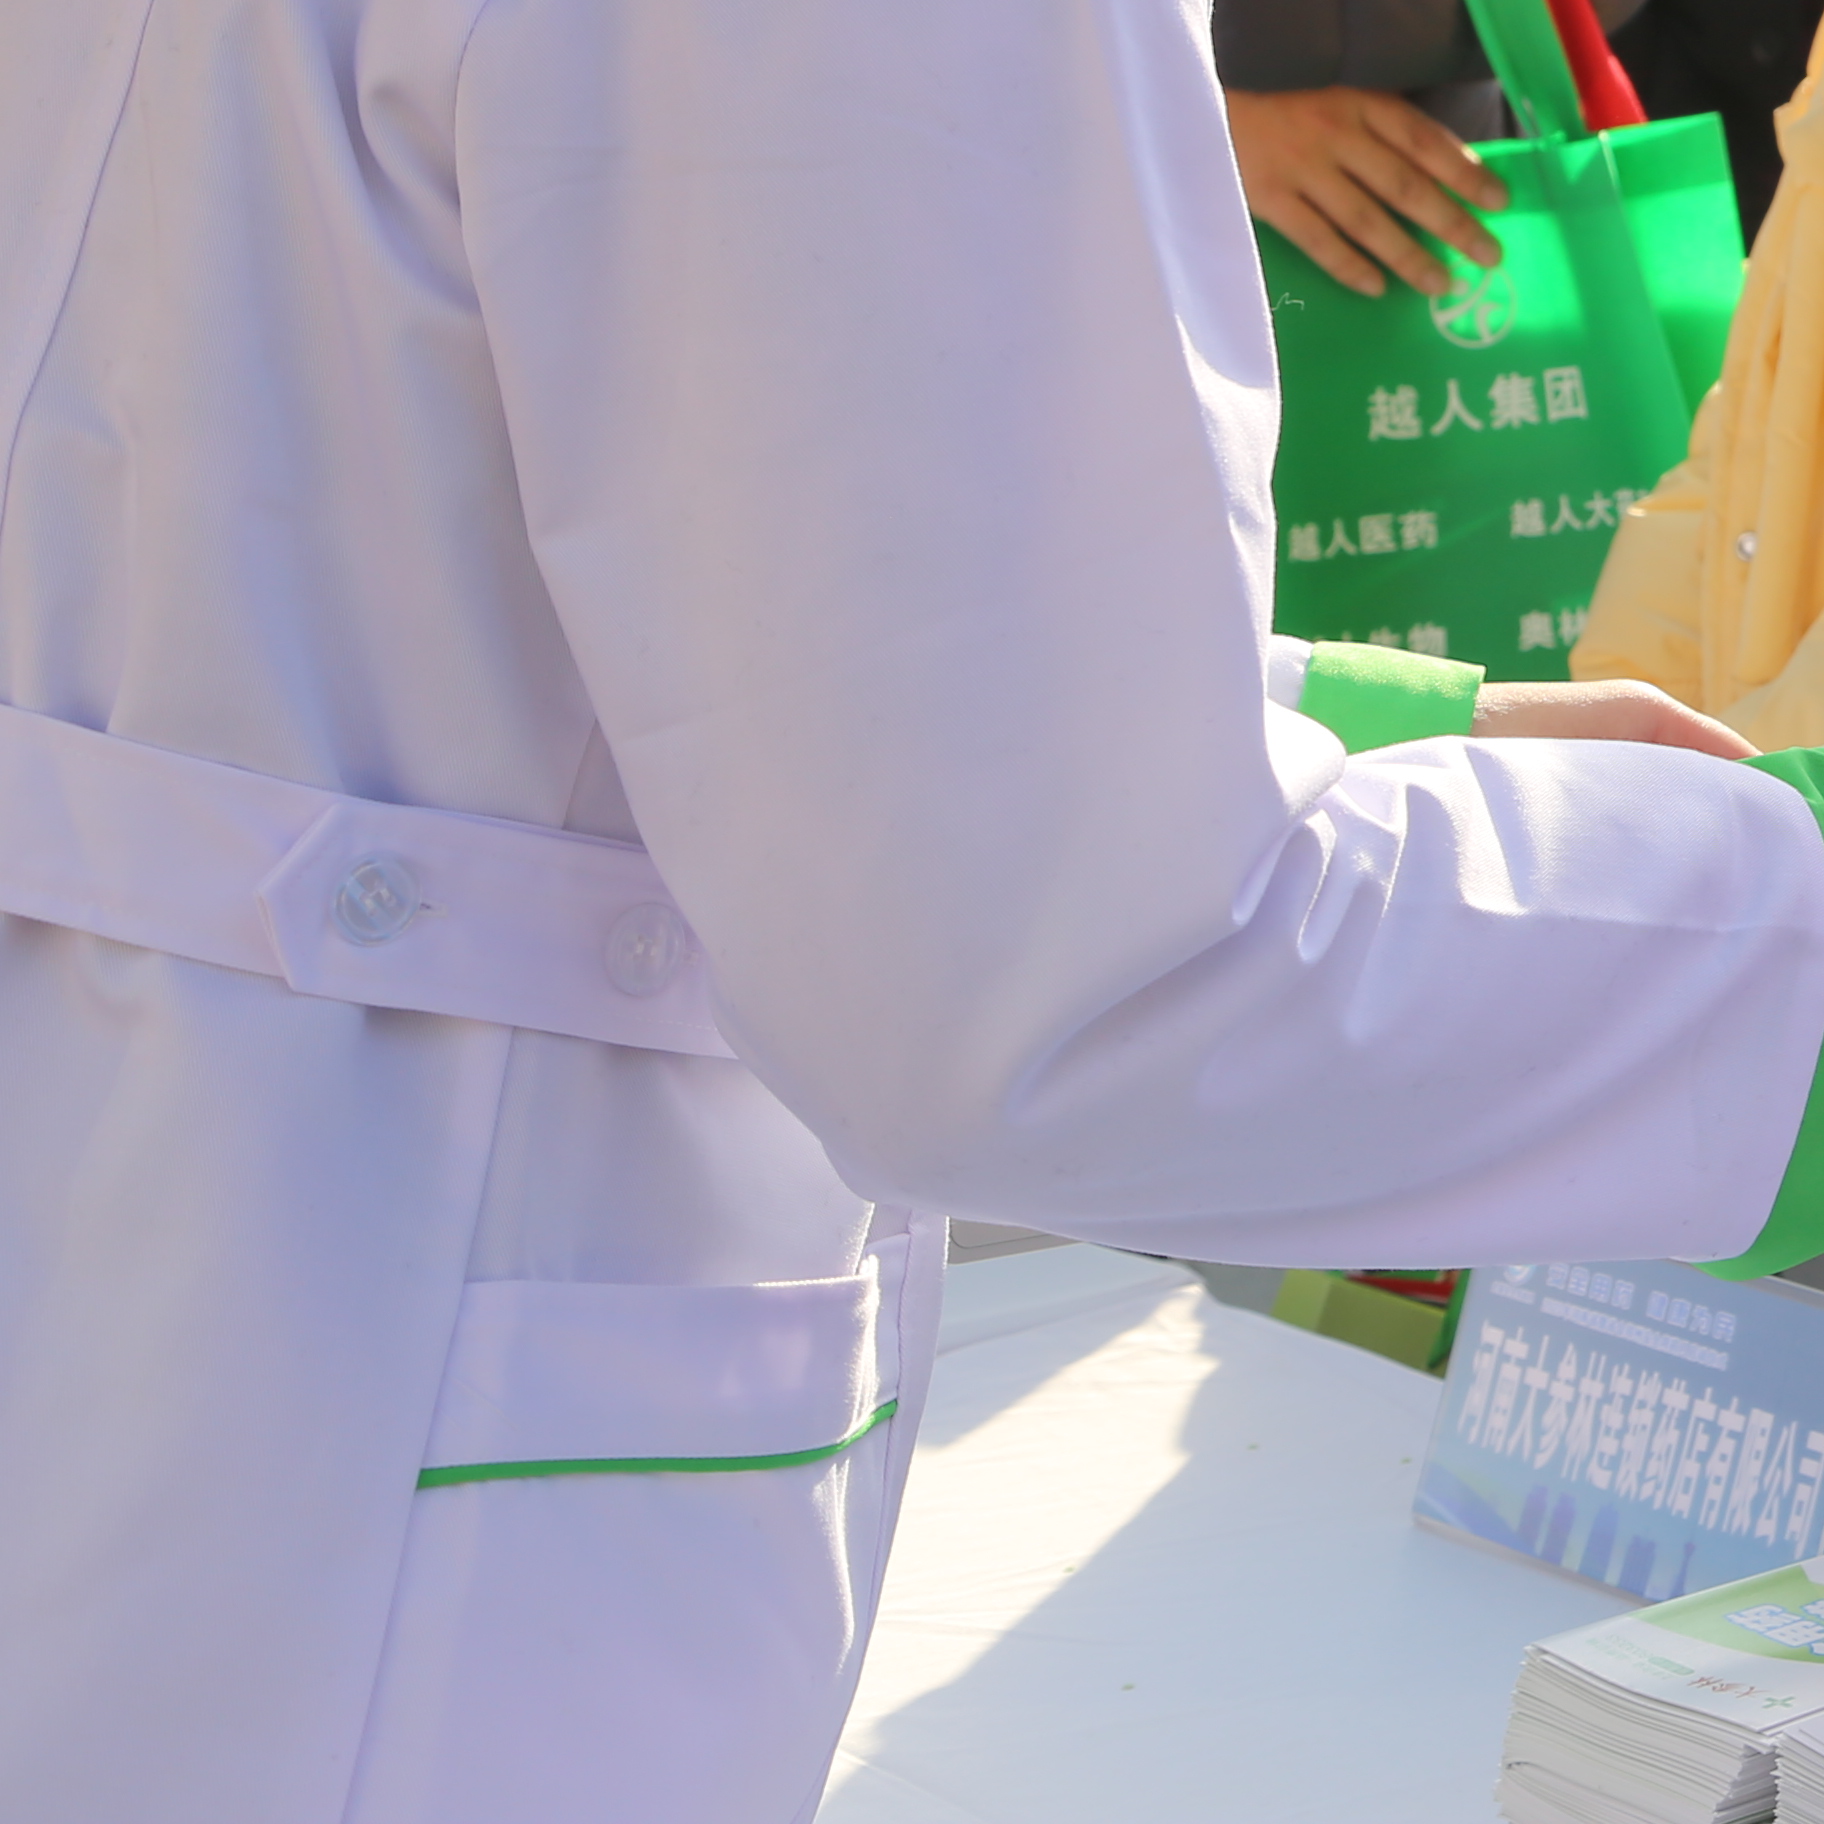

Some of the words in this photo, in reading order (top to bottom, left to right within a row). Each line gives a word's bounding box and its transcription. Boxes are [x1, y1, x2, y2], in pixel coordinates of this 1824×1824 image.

[1367, 366, 1589, 441] 越人集团
[1288, 509, 1440, 562] 越人医药
